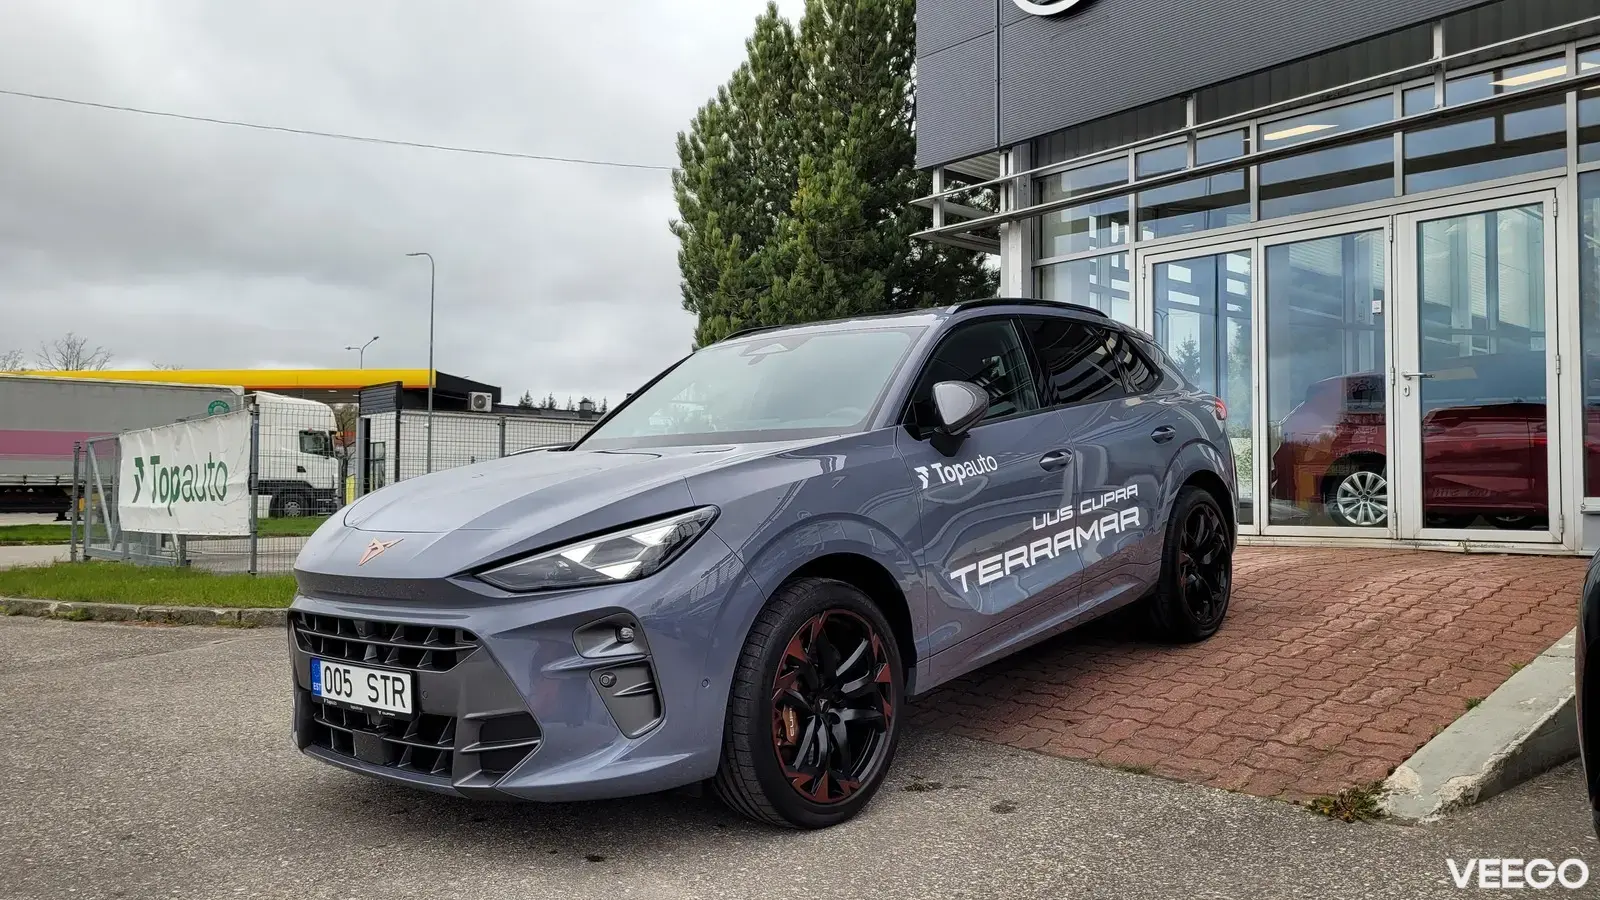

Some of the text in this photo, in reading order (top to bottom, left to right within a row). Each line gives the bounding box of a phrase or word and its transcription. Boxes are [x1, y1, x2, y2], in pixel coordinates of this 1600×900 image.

[150, 452, 228, 516] Topauto
[931, 454, 998, 485] Topauto
[1032, 484, 1138, 530] UUS CUPRA
[950, 507, 1140, 592] TERRAMAR
[324, 666, 406, 708] 005 STR
